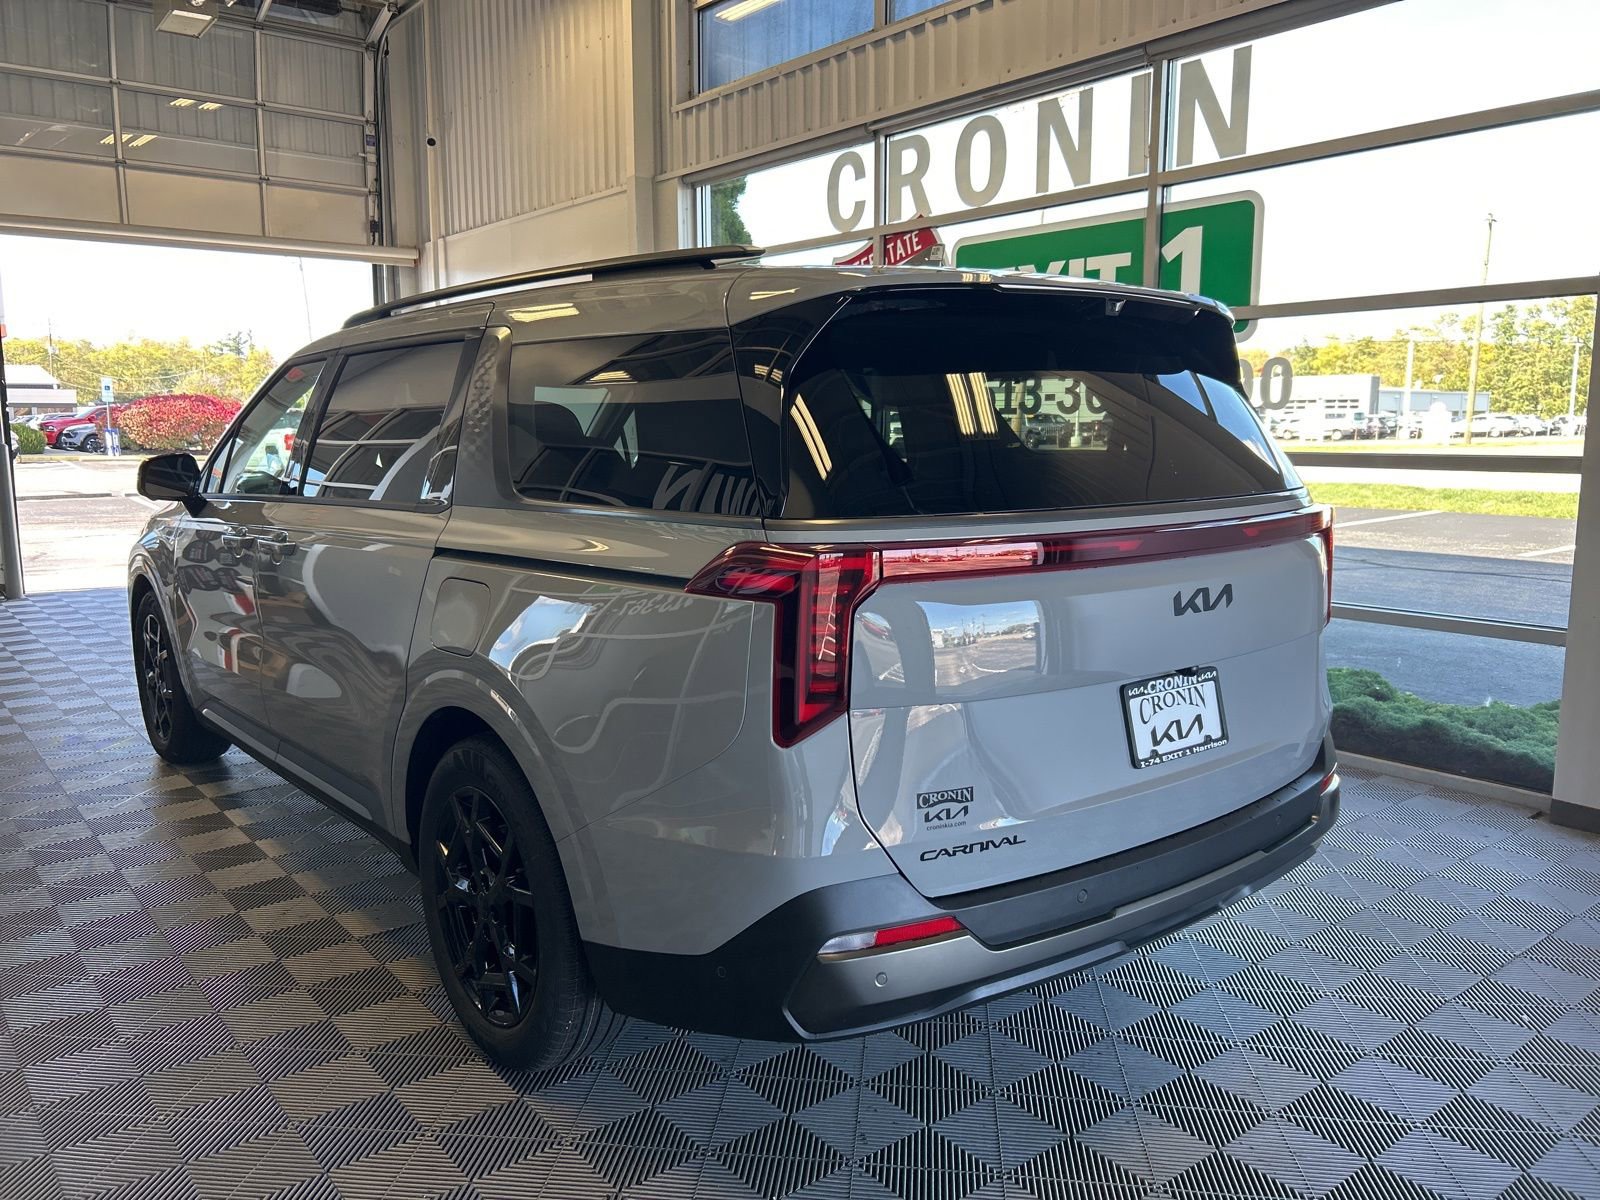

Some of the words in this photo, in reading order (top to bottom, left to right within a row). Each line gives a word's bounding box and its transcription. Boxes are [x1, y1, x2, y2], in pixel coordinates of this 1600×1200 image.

[827, 45, 1253, 233] CRONIN
[1161, 225, 1203, 294] 1
[1173, 584, 1233, 616] KIA
[1139, 684, 1207, 725] CRONIN
[1150, 713, 1204, 747] KIA
[1140, 757, 1161, 768] I-74
[1162, 751, 1184, 762] EXIT
[1193, 739, 1227, 753] Harrison
[918, 787, 972, 808] CRONIN
[924, 805, 969, 823] KIA
[926, 821, 967, 832] croninkia.com
[919, 835, 1027, 861] CARNIVAL
